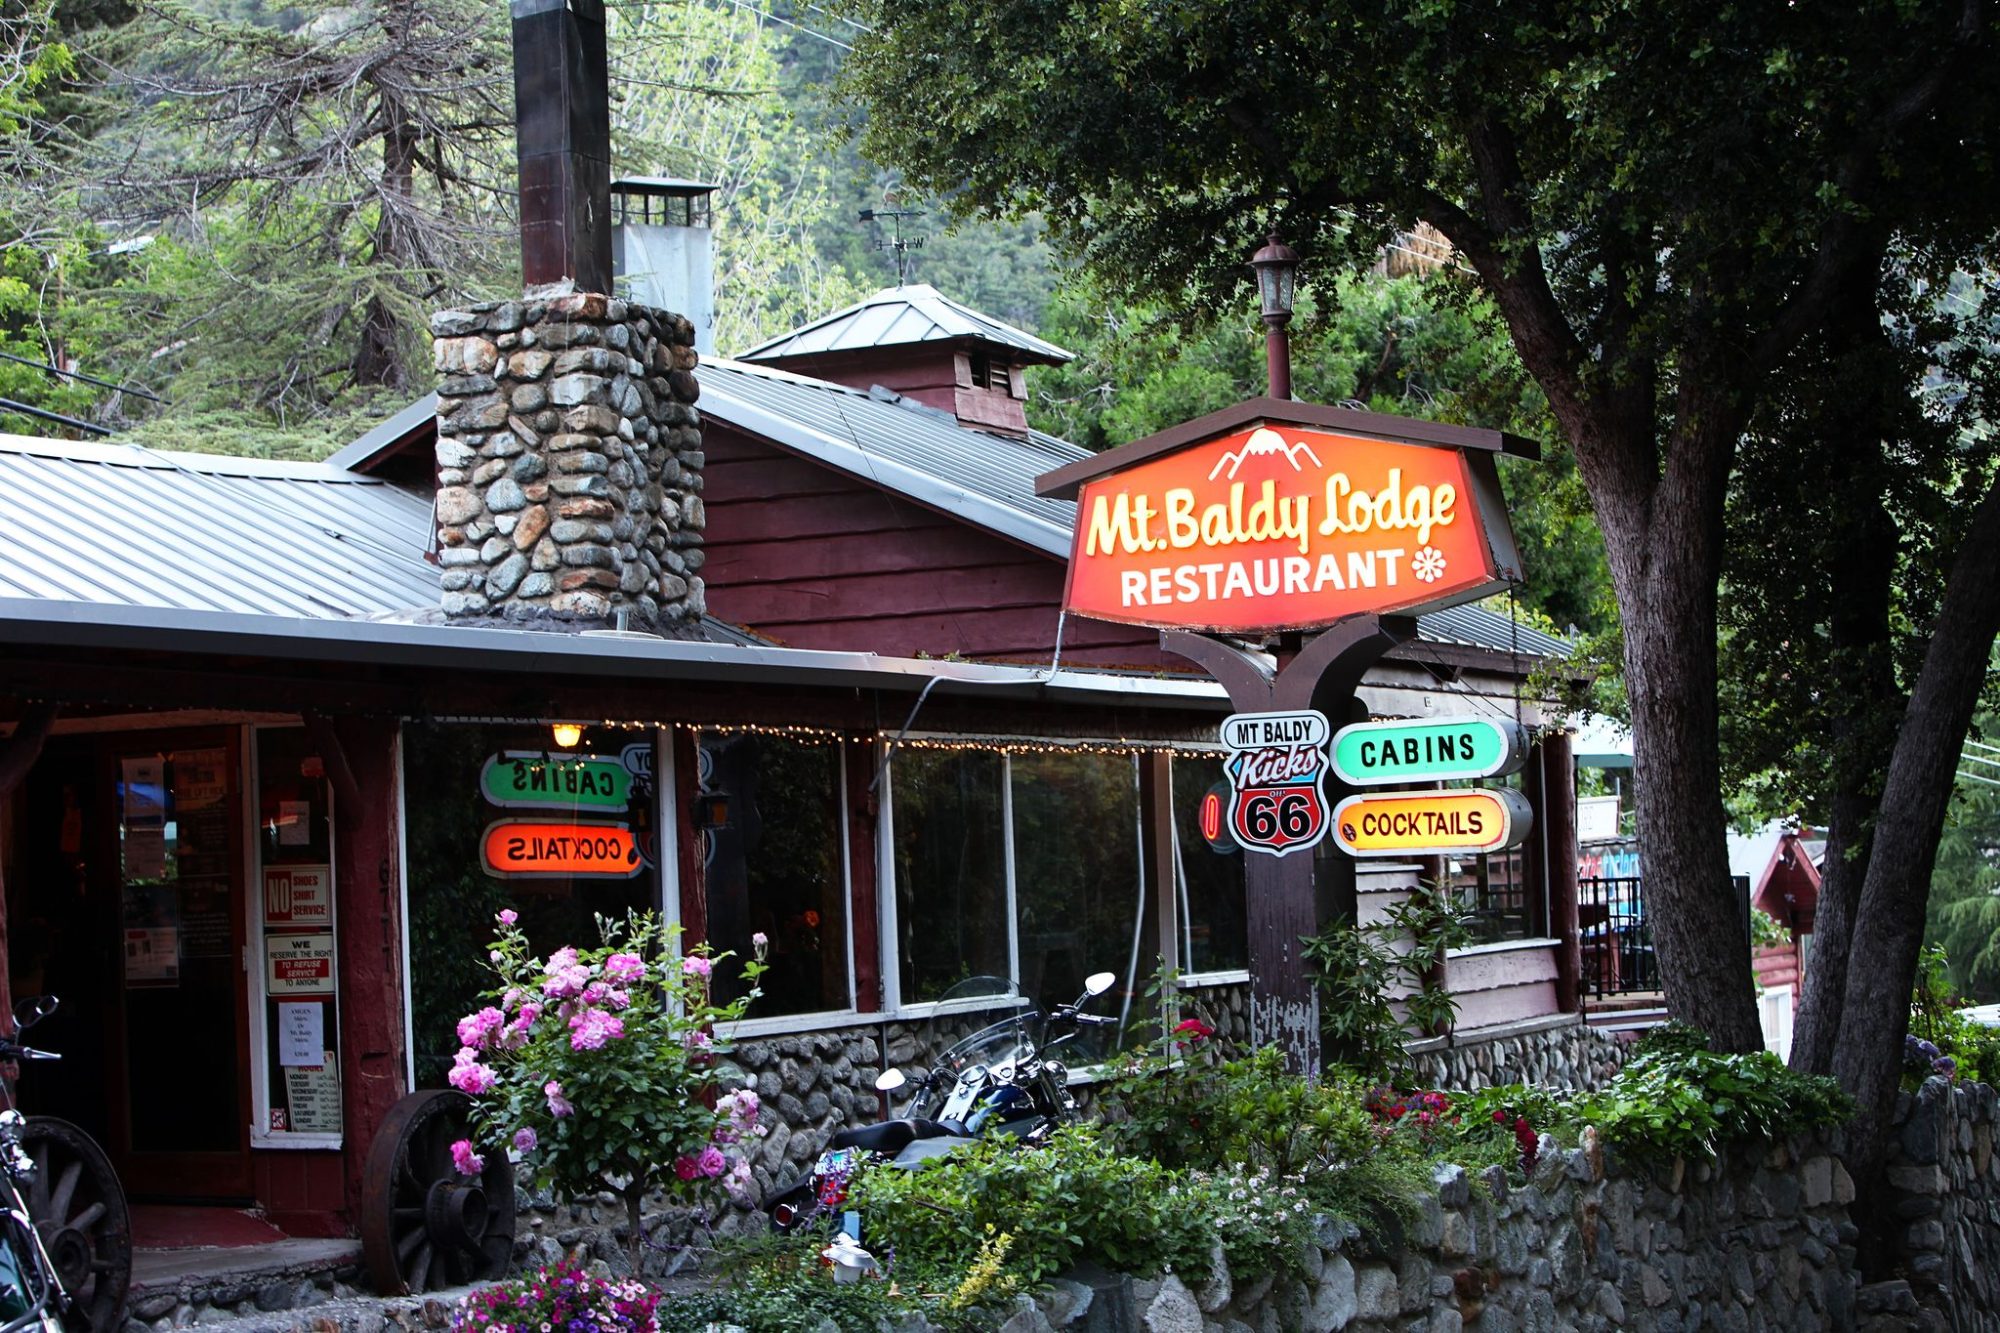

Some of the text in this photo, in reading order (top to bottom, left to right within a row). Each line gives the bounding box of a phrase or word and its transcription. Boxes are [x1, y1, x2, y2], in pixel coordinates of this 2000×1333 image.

[1319, 468, 1457, 546] Lodge
[1120, 549, 1406, 608] RESTAURANT
[1237, 720, 1312, 744] MT BALDY
[1361, 733, 1475, 768] CABINS
[1236, 745, 1318, 790] Kicks
[1245, 794, 1313, 841] 66
[1362, 811, 1483, 837] COCKTAILS
[293, 875, 319, 887] SHOES
[268, 878, 290, 914] NO
[293, 890, 315, 901] SHIRT
[293, 904, 326, 916] SERVICE
[270, 949, 333, 959] RESERVE THE RIGHT
[292, 941, 311, 949] WE
[282, 960, 321, 969] TO REFUSE
[287, 969, 317, 977] SERVICE
[285, 978, 320, 987] TO ANYONE
